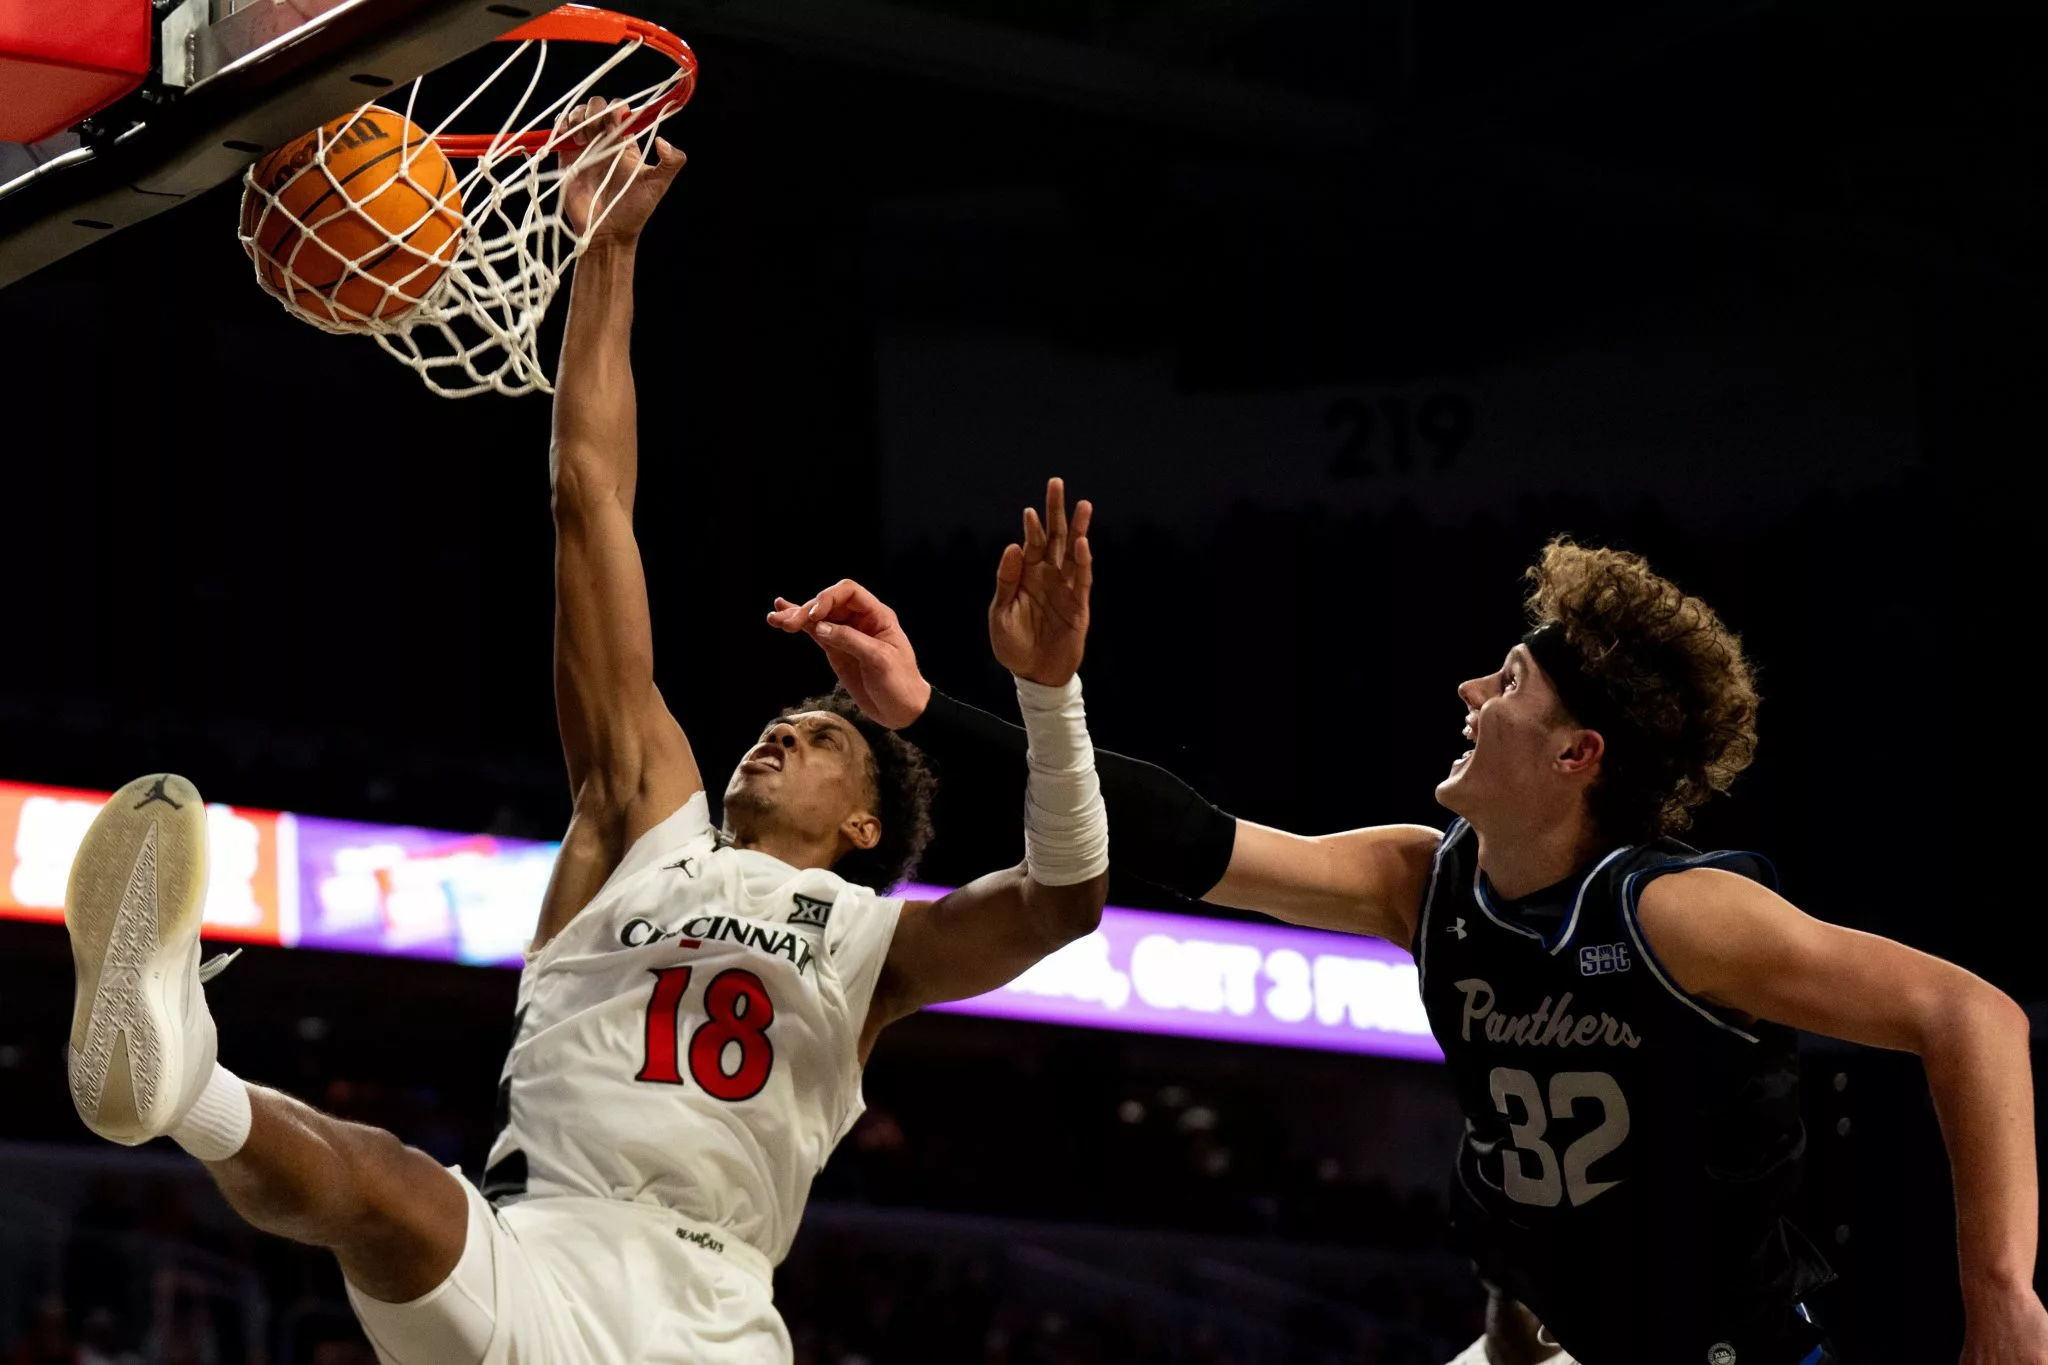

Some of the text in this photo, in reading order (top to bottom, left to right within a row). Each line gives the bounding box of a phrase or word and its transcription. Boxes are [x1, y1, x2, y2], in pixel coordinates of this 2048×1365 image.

[1325, 394, 1474, 478] 219
[1580, 942, 1631, 976] SBC
[635, 965, 774, 1101] 18
[1453, 978, 1642, 1049] Panthers
[1489, 1066, 1631, 1208] 32
